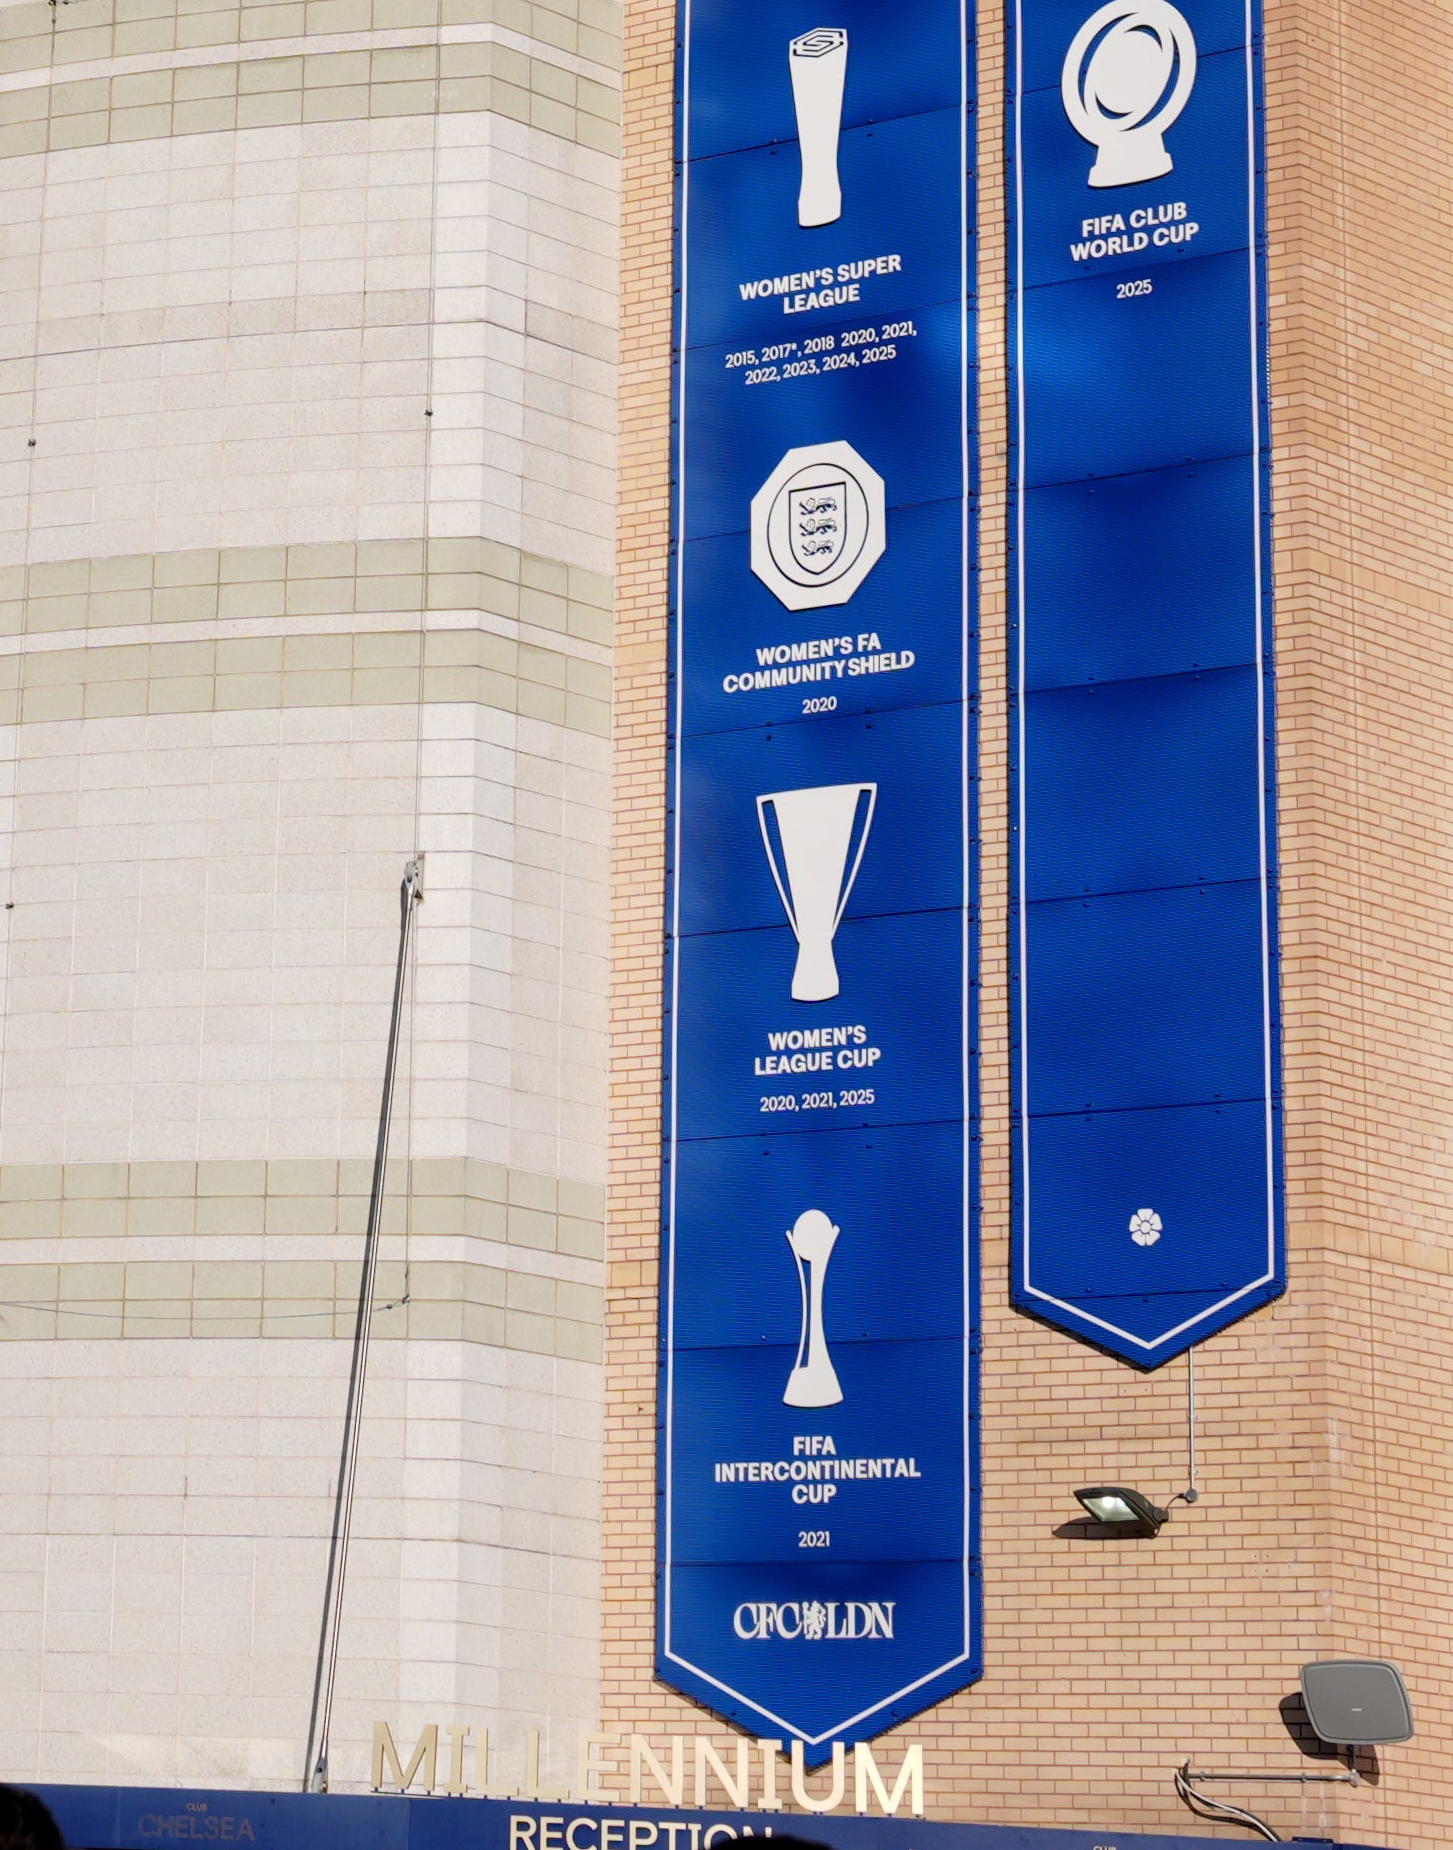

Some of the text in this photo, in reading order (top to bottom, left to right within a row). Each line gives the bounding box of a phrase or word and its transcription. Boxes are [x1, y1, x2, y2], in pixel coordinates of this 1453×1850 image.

[1082, 201, 1188, 238] FIFA CLUB
[1070, 222, 1200, 262] WORLD CUP
[739, 254, 902, 301] WOMEN'S SUPER
[1116, 278, 1153, 299] 2025
[783, 283, 860, 314] LEAGUE
[725, 350, 760, 368] 2015,
[841, 328, 879, 347] 2020,
[881, 321, 917, 340] 2021,
[745, 344, 896, 385] 2022, 2023, 2024, 2025
[755, 632, 881, 666] WOMEN'S FA
[722, 650, 915, 694] COMMUNITY SHIELD
[802, 696, 837, 715] 2020
[767, 1024, 867, 1051] WOMEN'S
[754, 1047, 881, 1076] LEAGUE CUP
[760, 1088, 875, 1112] 2020, 2021, 2025
[793, 1435, 837, 1456] FIFA
[714, 1458, 922, 1483] INTERCONTINENTAL
[791, 1484, 837, 1504] CUP
[798, 1531, 831, 1547] 2021
[371, 1720, 924, 1815] MILLENNIUM
[186, 1803, 207, 1812] CLUB
[138, 1814, 255, 1842] CHELSEA
